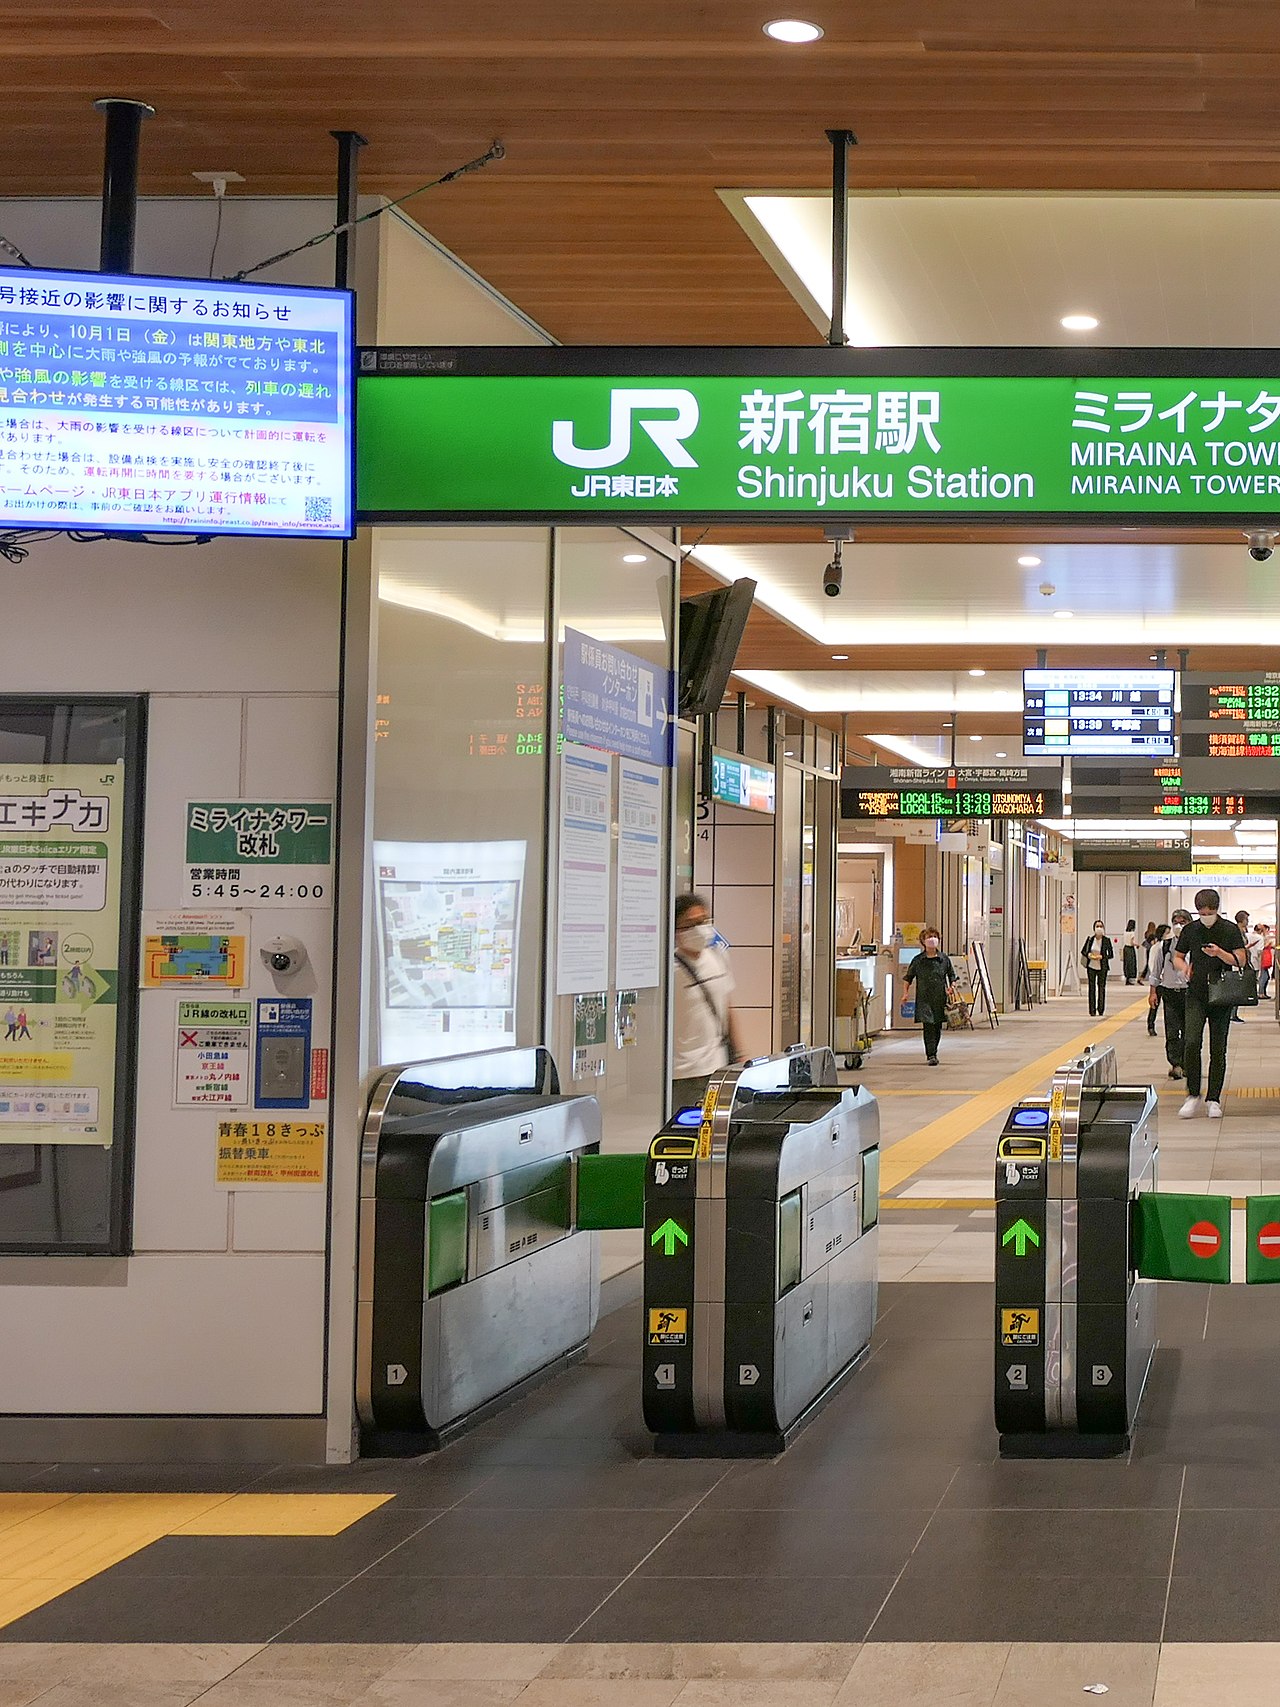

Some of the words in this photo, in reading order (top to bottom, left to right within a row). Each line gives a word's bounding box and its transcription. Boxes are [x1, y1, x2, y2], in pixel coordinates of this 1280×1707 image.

[0, 285, 291, 321] 号接近の影響に関するお知らせ
[737, 390, 942, 455] 新宿駅
[552, 388, 699, 469] JR
[1071, 442, 1197, 466] MIRAINA
[571, 475, 679, 497] JR東日本
[737, 465, 893, 506] Shinjuku
[919, 465, 1034, 499] Station
[1071, 475, 1181, 495] MIRAINA
[1072, 690, 1103, 702] 13:34
[1247, 686, 1279, 697] 13:32
[1247, 697, 1279, 708] 13:47
[1247, 708, 1279, 719] 14:02
[100, 775, 115, 784] JR
[713, 760, 720, 794] 3
[900, 793, 930, 804] LOCAL
[955, 793, 991, 804] 13:39
[1183, 797, 1209, 806] 13:34
[0, 794, 103, 827] エキナカ
[900, 804, 930, 814] LOCAL
[955, 804, 991, 814] 13:49
[1183, 805, 1209, 815] 13:37
[191, 808, 327, 832] ミライナタワー
[239, 833, 278, 856] 改札
[0, 865, 100, 875] aのタッチで自動精算!
[190, 869, 240, 880] 営業時間
[744, 1369, 752, 1380] 2
[1014, 1369, 1022, 1380] 2
[1096, 1369, 1105, 1380] 3
